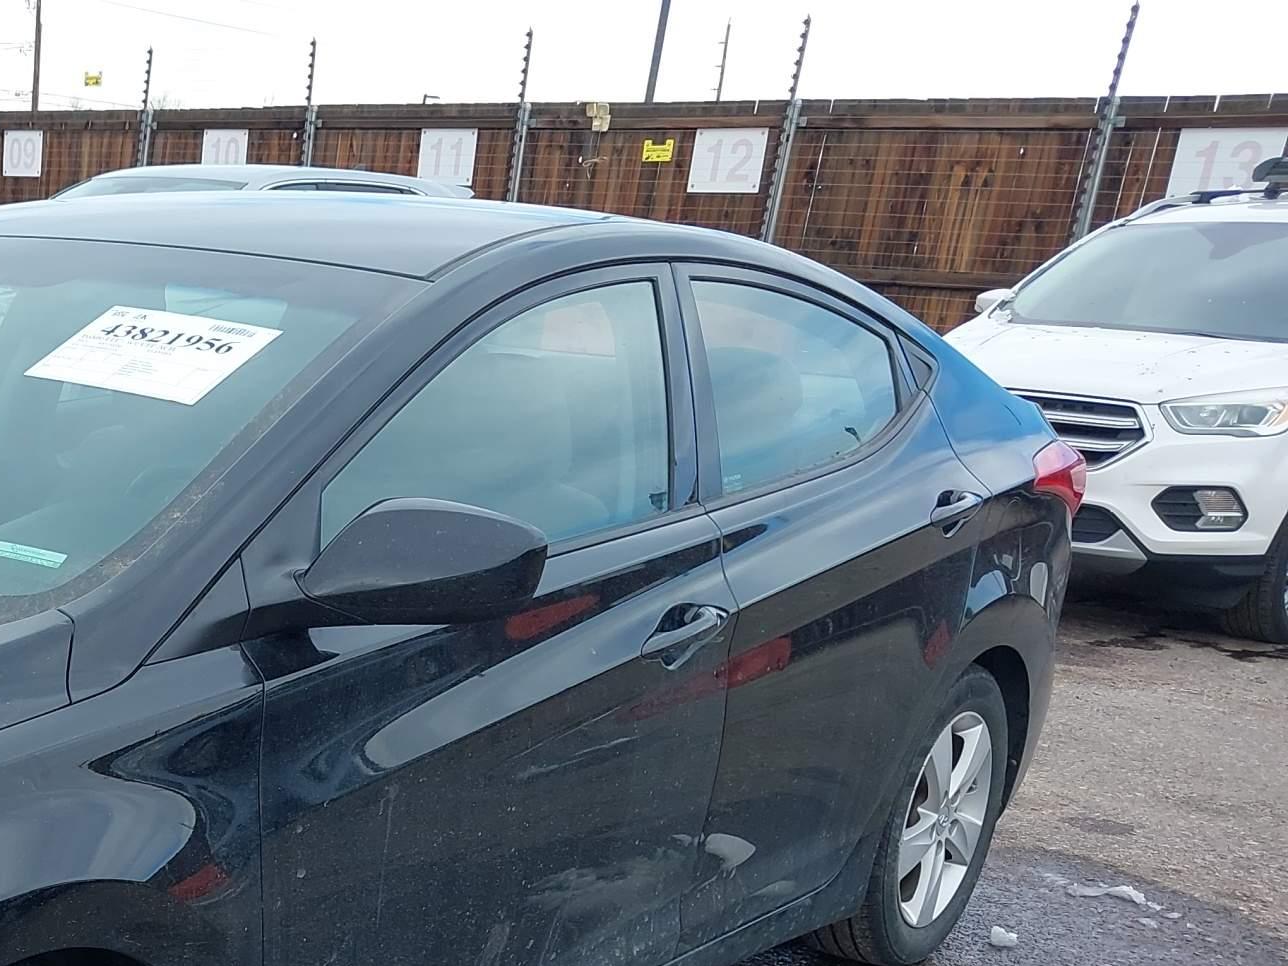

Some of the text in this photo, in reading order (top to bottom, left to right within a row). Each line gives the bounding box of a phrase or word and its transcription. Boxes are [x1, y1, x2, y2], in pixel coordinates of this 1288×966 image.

[9, 137, 36, 168] 09
[211, 137, 240, 165] 10
[430, 137, 464, 177] 11
[706, 138, 754, 183] 12
[1194, 140, 1263, 192] 13
[100, 322, 242, 355] 43821956
